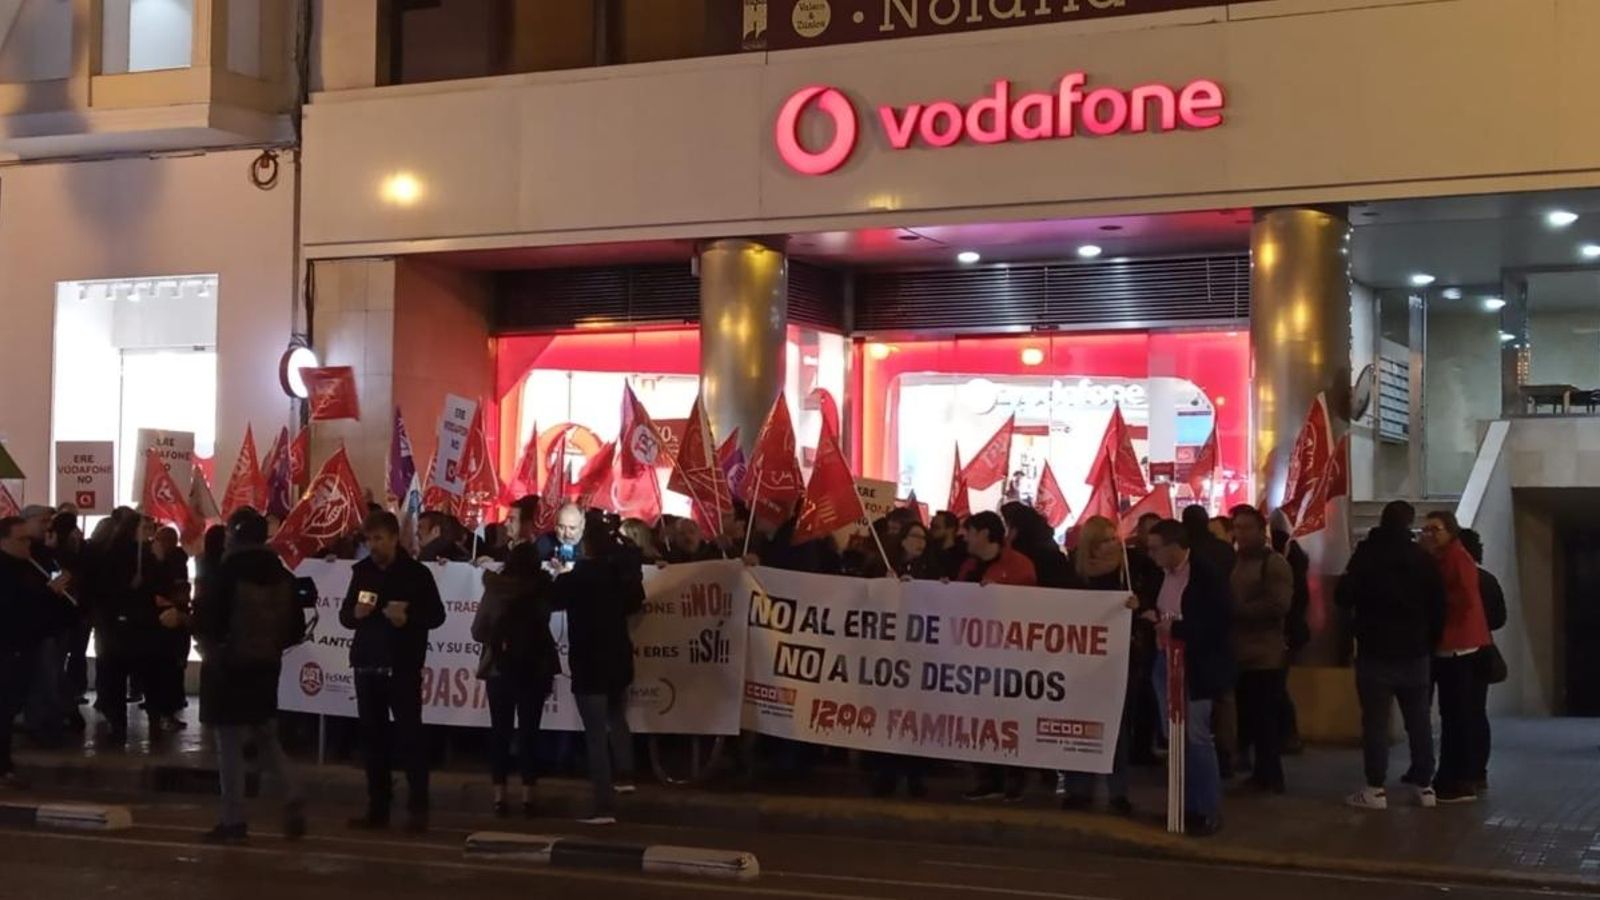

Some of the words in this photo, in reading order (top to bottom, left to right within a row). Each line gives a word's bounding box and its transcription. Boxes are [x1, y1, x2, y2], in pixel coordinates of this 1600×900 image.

[880, 73, 1223, 150] vodafone
[73, 454, 94, 464] ERE
[57, 464, 112, 475] VODAFONE
[77, 475, 93, 484] NO
[749, 592, 794, 633] NO
[799, 605, 836, 636] AL
[844, 609, 897, 642] ERE
[906, 613, 941, 645] DE
[949, 616, 1110, 656] VODAFONE
[437, 641, 445, 652] Y
[446, 642, 463, 653] SU
[643, 645, 680, 659] ERES
[777, 645, 822, 681] NO
[828, 654, 849, 683] A
[858, 657, 911, 688] LOS
[921, 662, 1066, 702] DESPIDOS
[809, 698, 878, 737] 1200
[886, 708, 1020, 757] FAMILIAS
[1040, 721, 1083, 736] CCOO
